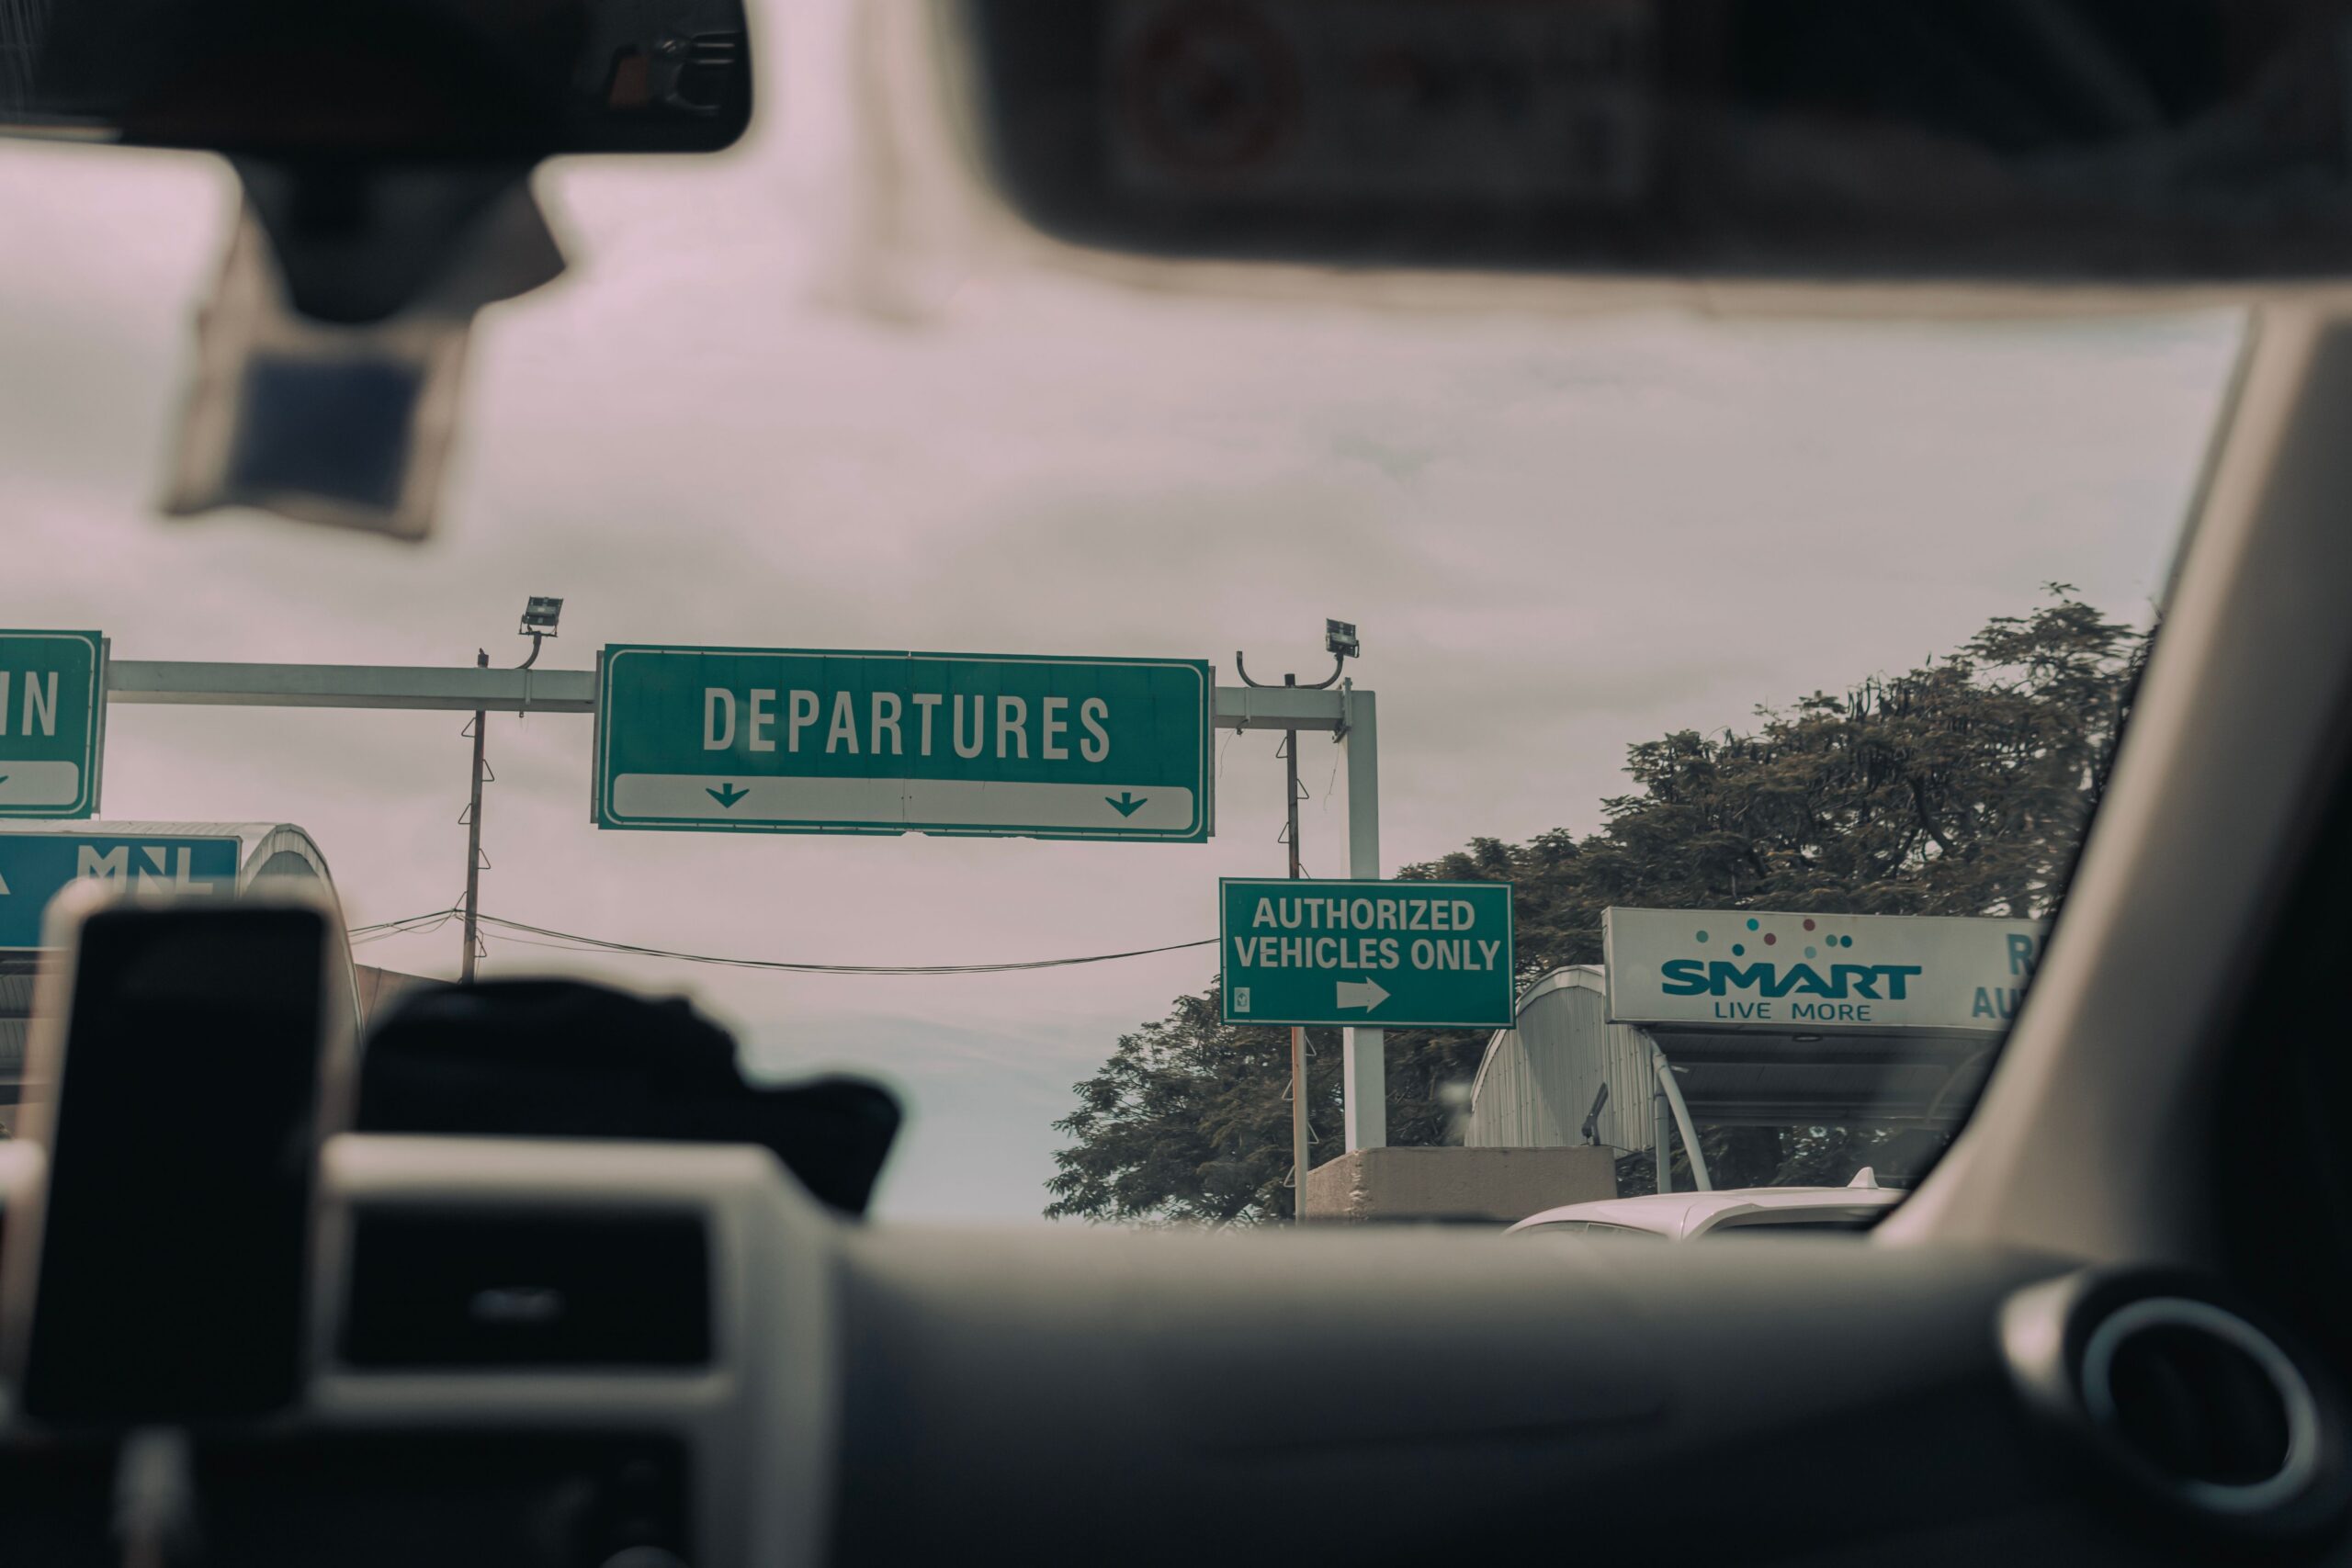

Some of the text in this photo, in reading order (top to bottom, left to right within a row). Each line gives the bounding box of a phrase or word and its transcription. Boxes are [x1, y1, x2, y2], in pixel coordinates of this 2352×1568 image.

[703, 687, 1110, 762] DEPARTURES
[76, 845, 214, 895] MNL
[1252, 897, 1475, 931] AUTHORIZED
[1234, 937, 1501, 971] VEHICLES ONLY
[1661, 959, 1922, 999] SMART
[1714, 1001, 1871, 1021] LIVE MORE
